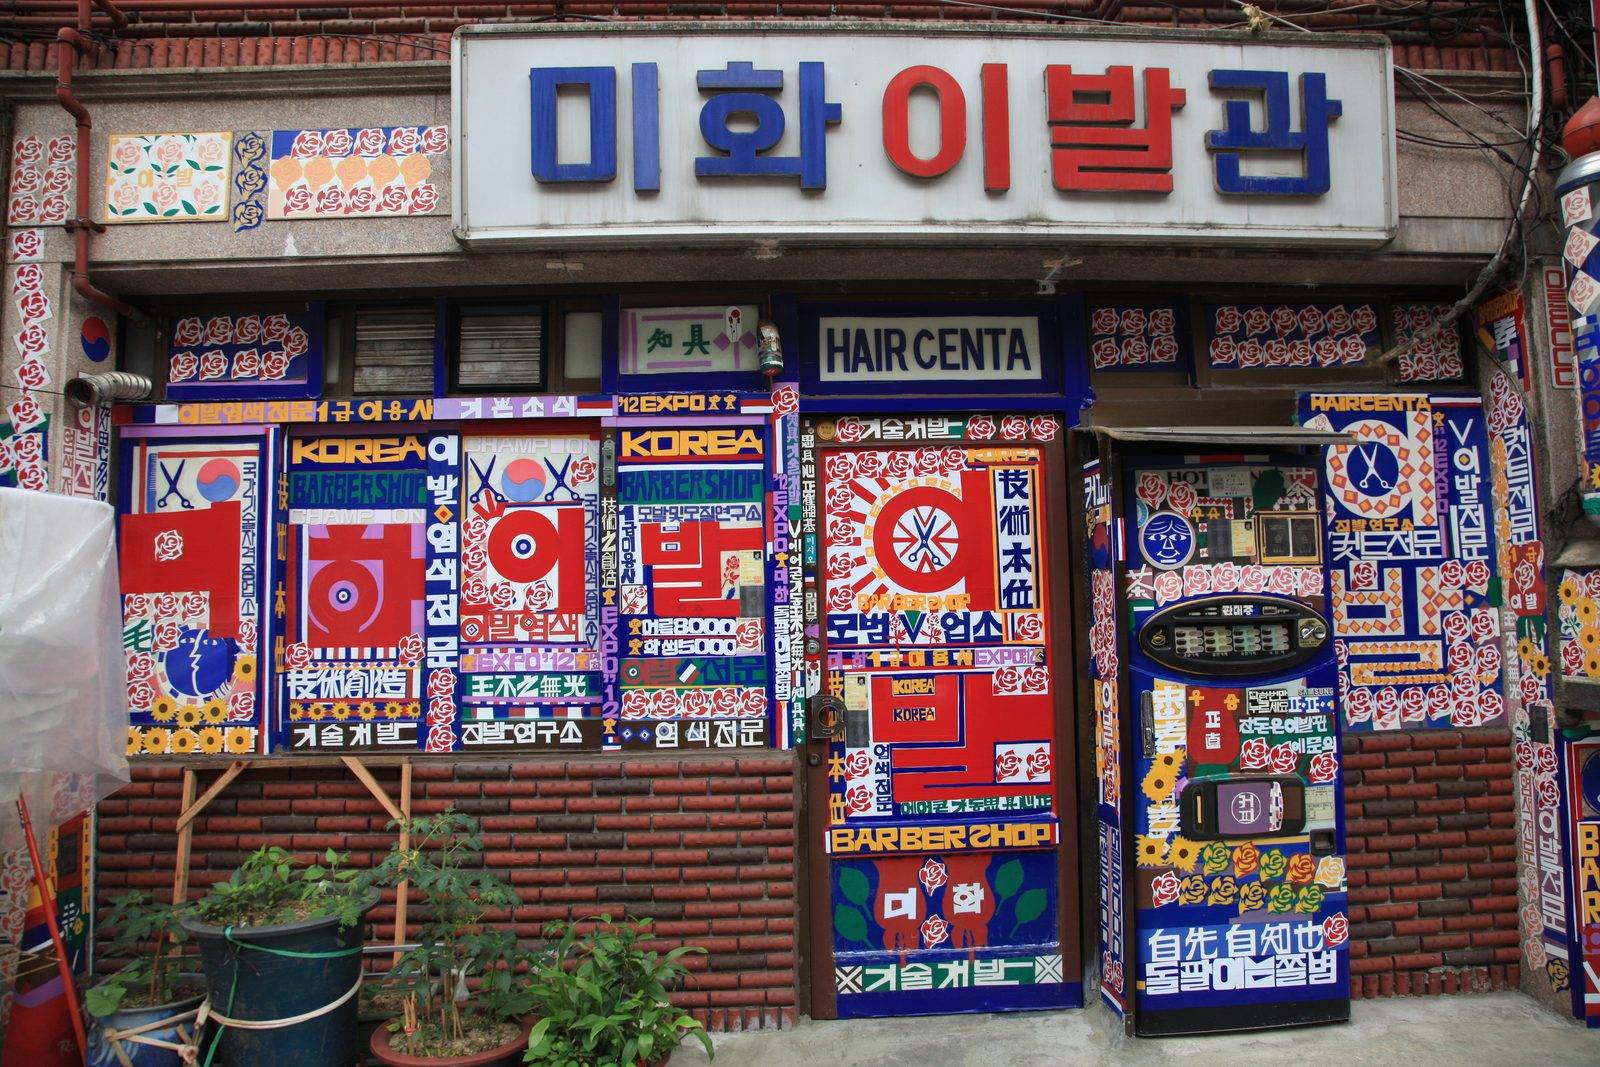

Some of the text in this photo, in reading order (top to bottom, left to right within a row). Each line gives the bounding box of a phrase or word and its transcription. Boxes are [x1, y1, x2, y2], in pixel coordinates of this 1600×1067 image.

[529, 60, 1342, 197] 미화이발관
[460, 395, 576, 419] 기쁜소식
[1310, 396, 1432, 412] HAIRCENTA
[292, 435, 426, 464] KOREA
[621, 429, 764, 457] KOREA
[291, 473, 427, 504] BARBERSHOP
[621, 470, 764, 501] BARBERSHOP
[894, 678, 935, 694] KOREA
[1298, 688, 1334, 696] SAMSUNG
[894, 709, 935, 722] KOREA
[832, 823, 1052, 852] BARBERSHOP
